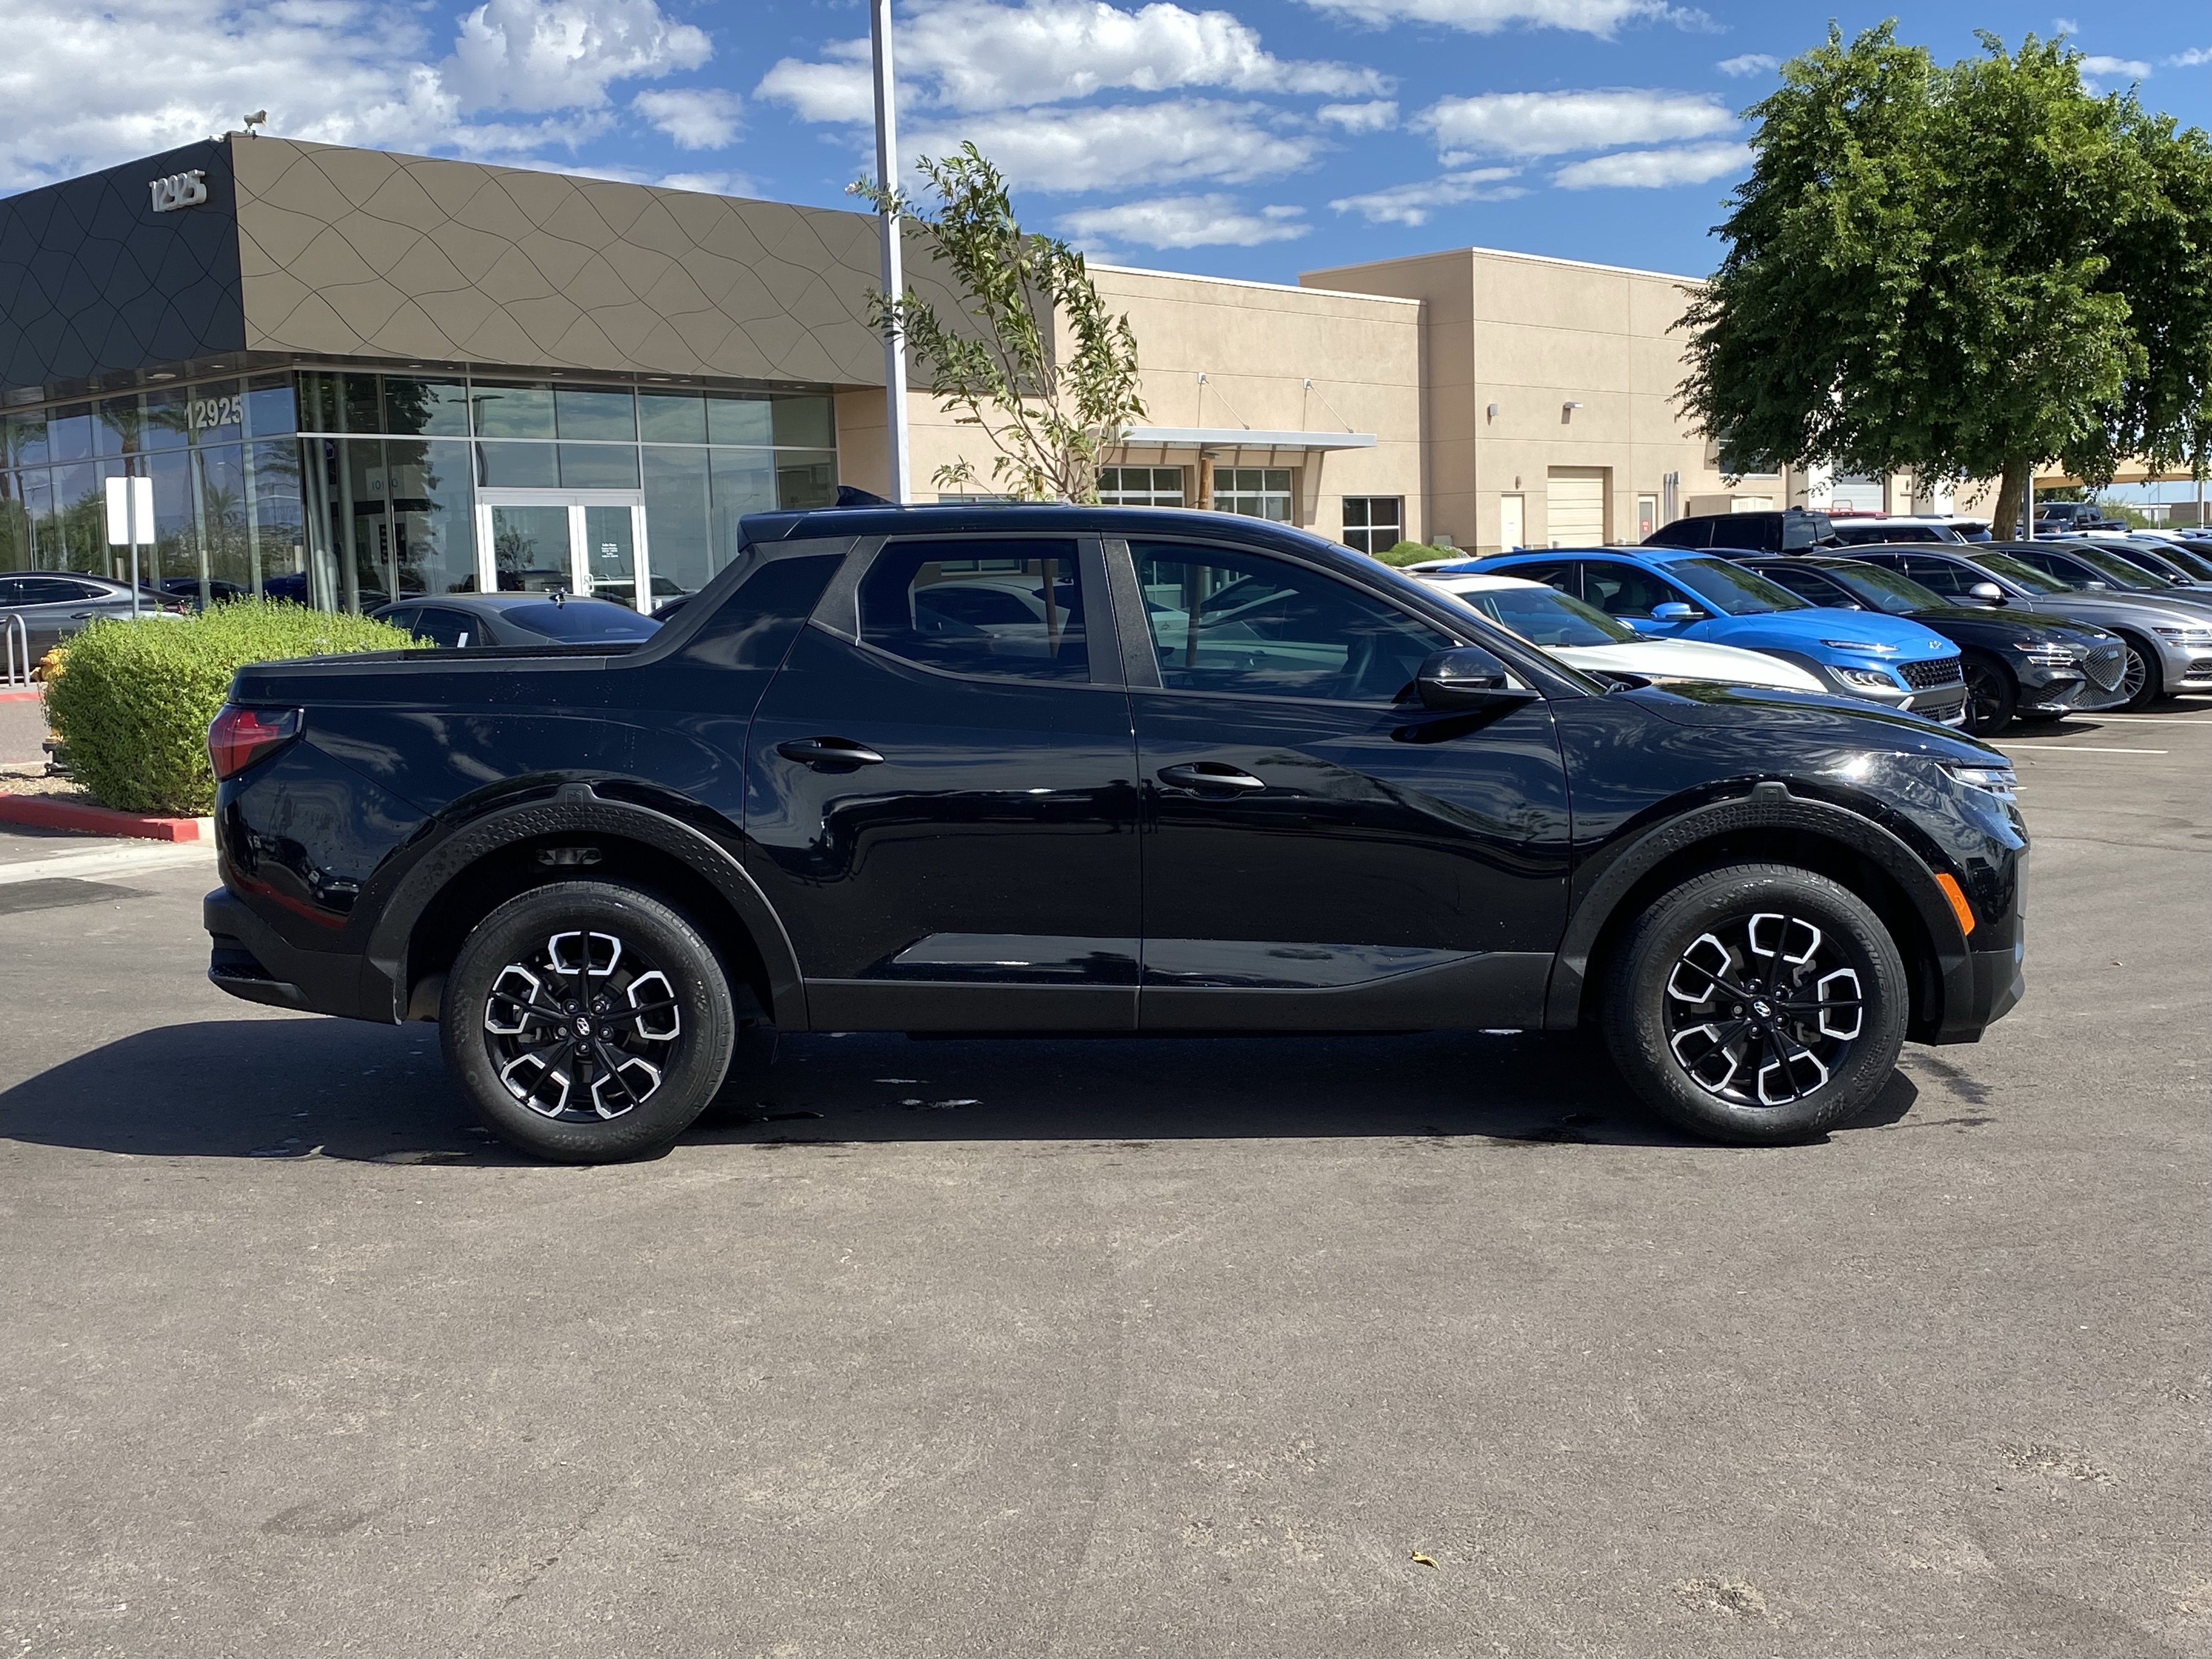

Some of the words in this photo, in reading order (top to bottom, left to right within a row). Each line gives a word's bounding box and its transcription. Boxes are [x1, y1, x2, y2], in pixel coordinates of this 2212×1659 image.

[149, 170, 207, 212] 12925
[185, 396, 244, 429] 12925
[1852, 928, 1890, 1005] CRUGEN
